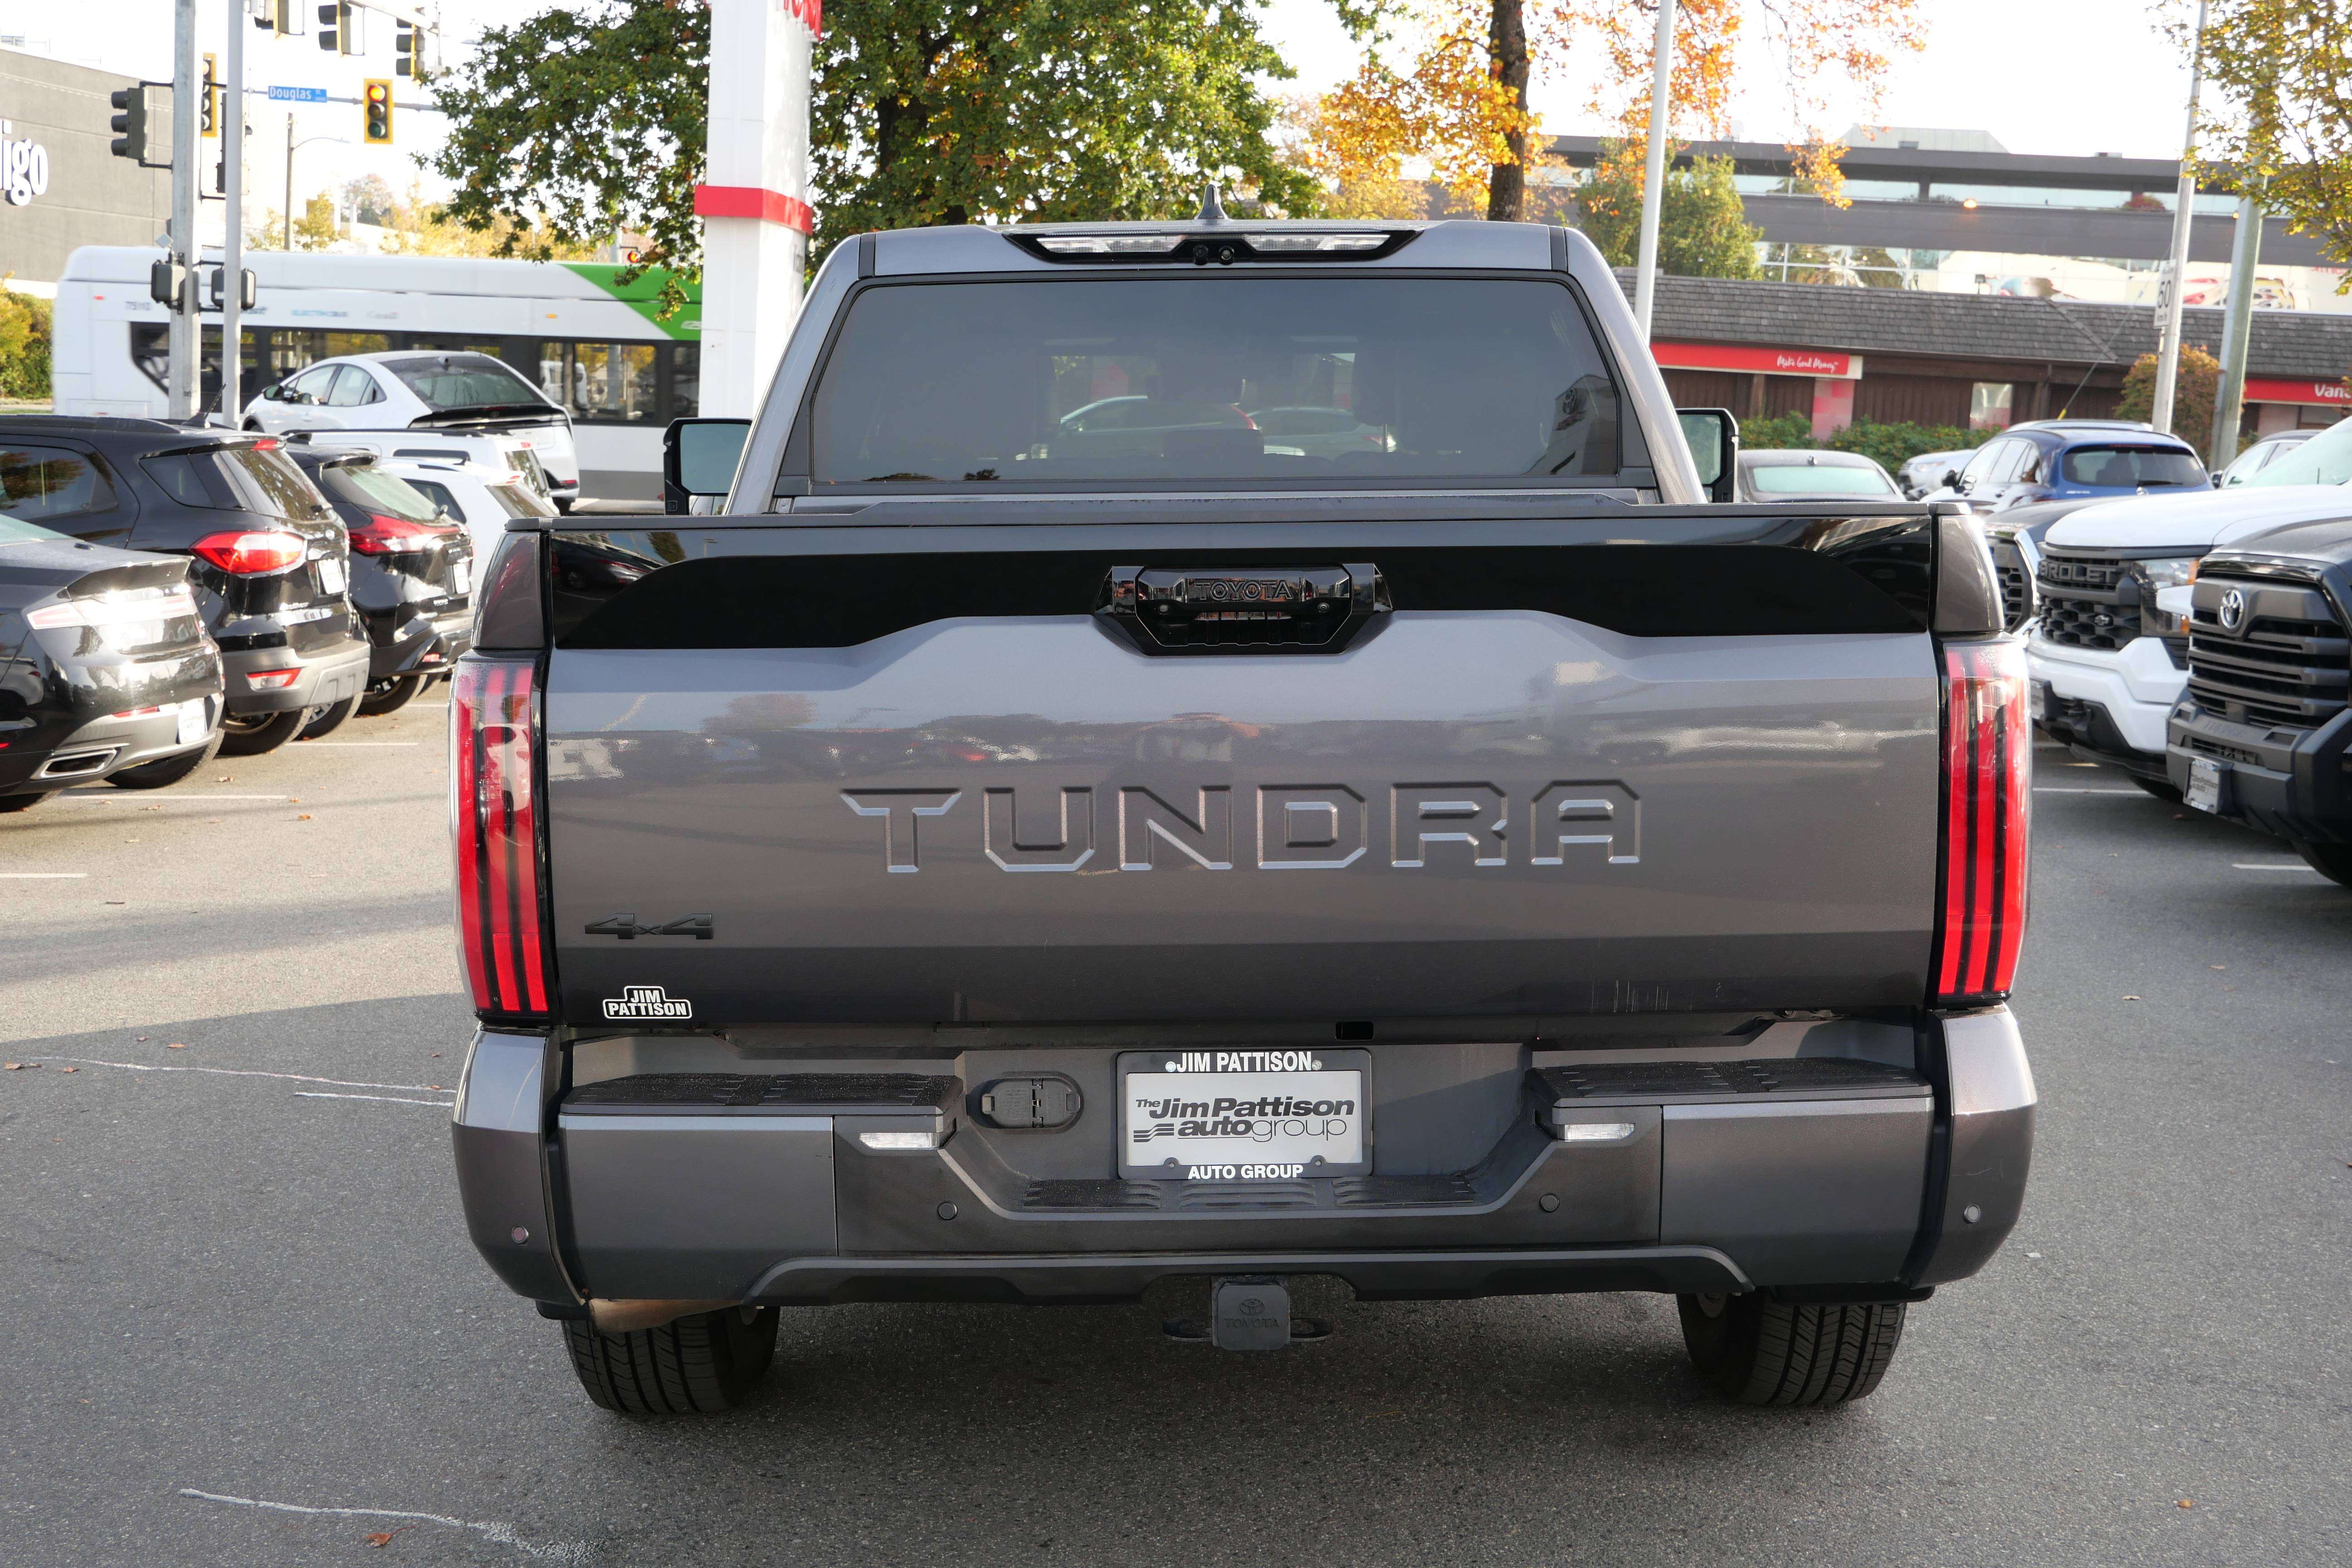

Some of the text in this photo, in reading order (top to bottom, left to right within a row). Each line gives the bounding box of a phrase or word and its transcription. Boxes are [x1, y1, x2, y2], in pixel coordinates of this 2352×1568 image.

[270, 87, 312, 101] Douglas
[2157, 280, 2171, 309] 50
[1777, 355, 1795, 368] Make
[1797, 356, 1812, 368] Good
[1195, 579, 1293, 602] TOYOTA
[840, 780, 1641, 872] TUNDRA
[631, 990, 661, 1003] JIM
[608, 1003, 687, 1016] PATTISON
[1176, 1051, 1311, 1072] JIM PATTISON
[1136, 1096, 1355, 1119] The Jim Pattison
[1188, 1164, 1303, 1180] AUTO GROUP
[1224, 1317, 1280, 1328] TOYOTA
